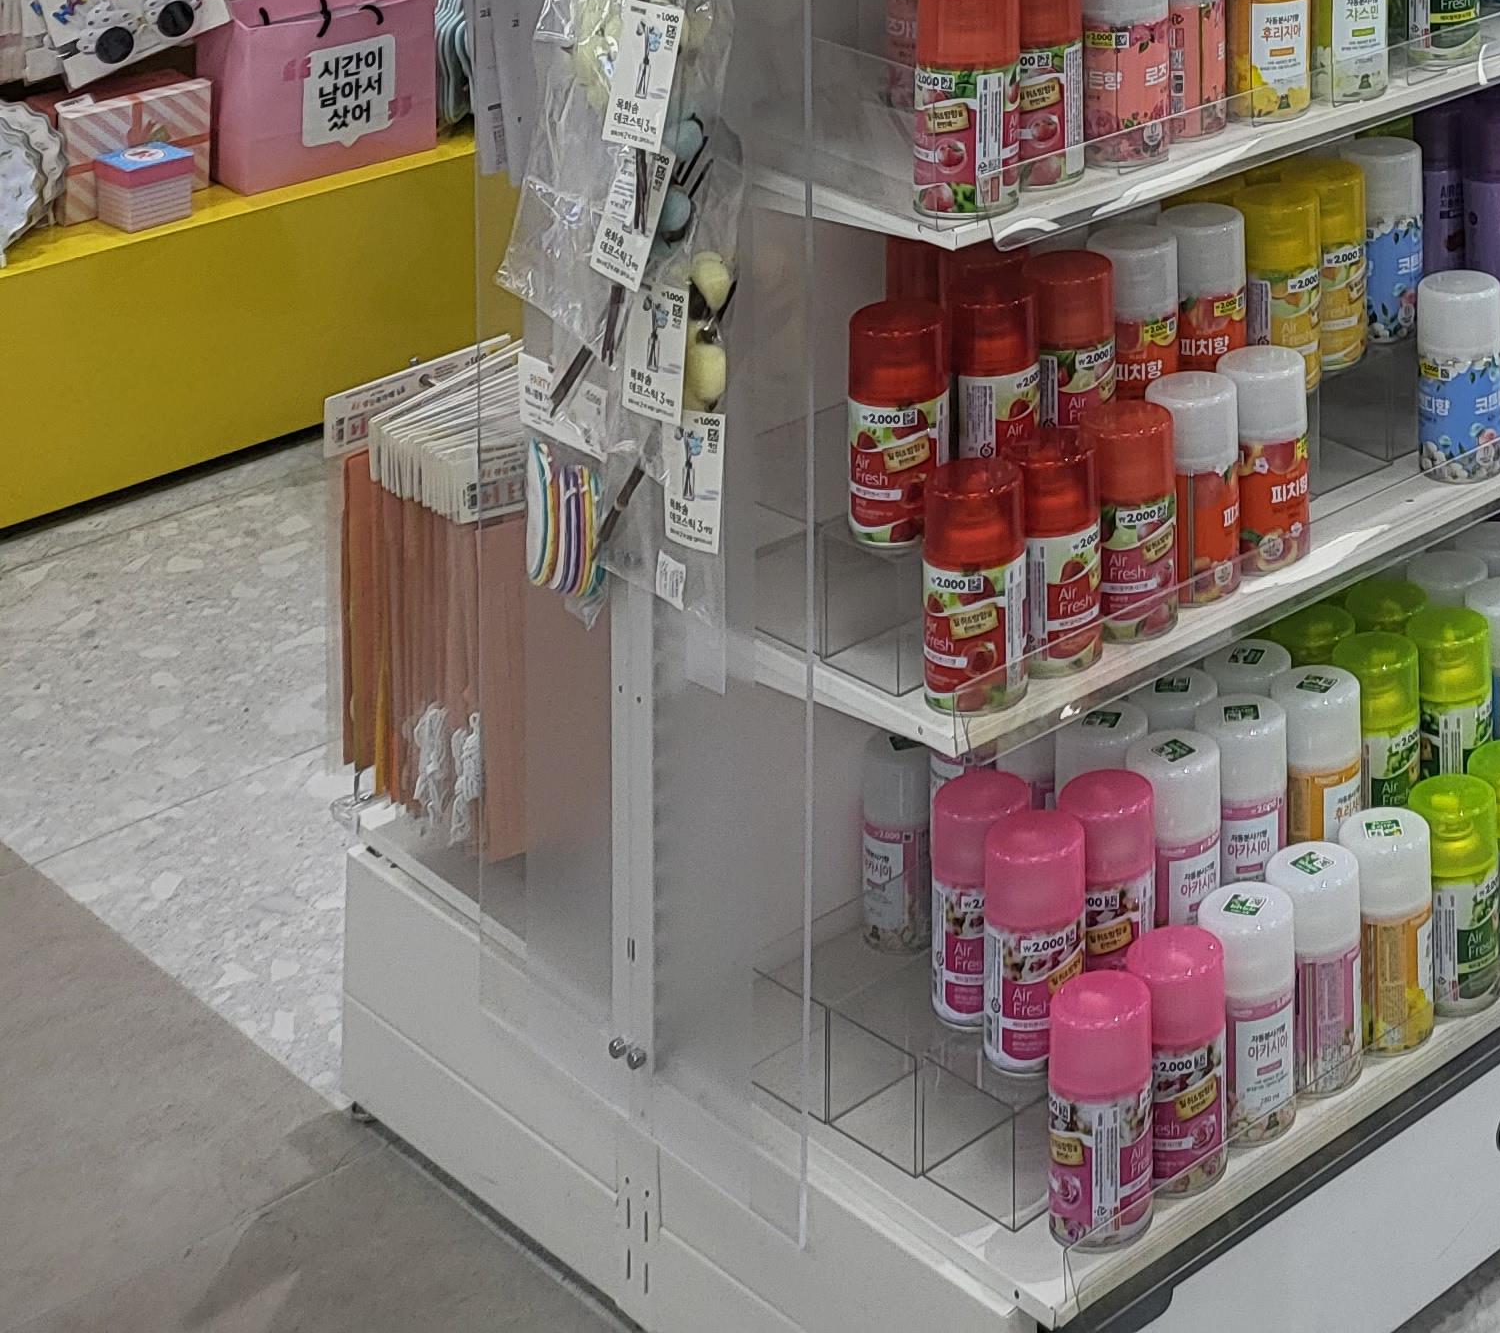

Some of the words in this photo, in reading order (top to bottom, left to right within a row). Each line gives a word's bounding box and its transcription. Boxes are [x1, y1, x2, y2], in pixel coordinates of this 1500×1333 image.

[1260, 23, 1302, 43] 후리지아
[318, 45, 384, 80] 시간이
[318, 74, 384, 109] 남아서
[328, 102, 372, 131] 샀어
[1179, 335, 1230, 358] 피치향
[1114, 359, 1163, 383] 피치향
[1068, 394, 1088, 410] Air
[1006, 422, 1025, 439] Air
[854, 453, 872, 470] Air
[854, 469, 889, 487] Fresh
[1109, 553, 1129, 569] Air
[1109, 565, 1146, 582] Fresh
[1058, 585, 1078, 603] Air
[1058, 595, 1093, 616] Fresh
[1381, 780, 1399, 794] Air
[1227, 839, 1271, 859] 아카시아
[1467, 929, 1486, 946] Air
[954, 942, 974, 958] Air
[954, 957, 984, 972] Fres
[1012, 987, 1034, 1004] Air
[1247, 1034, 1289, 1061] 아카시아
[1131, 1145, 1145, 1160] Air
